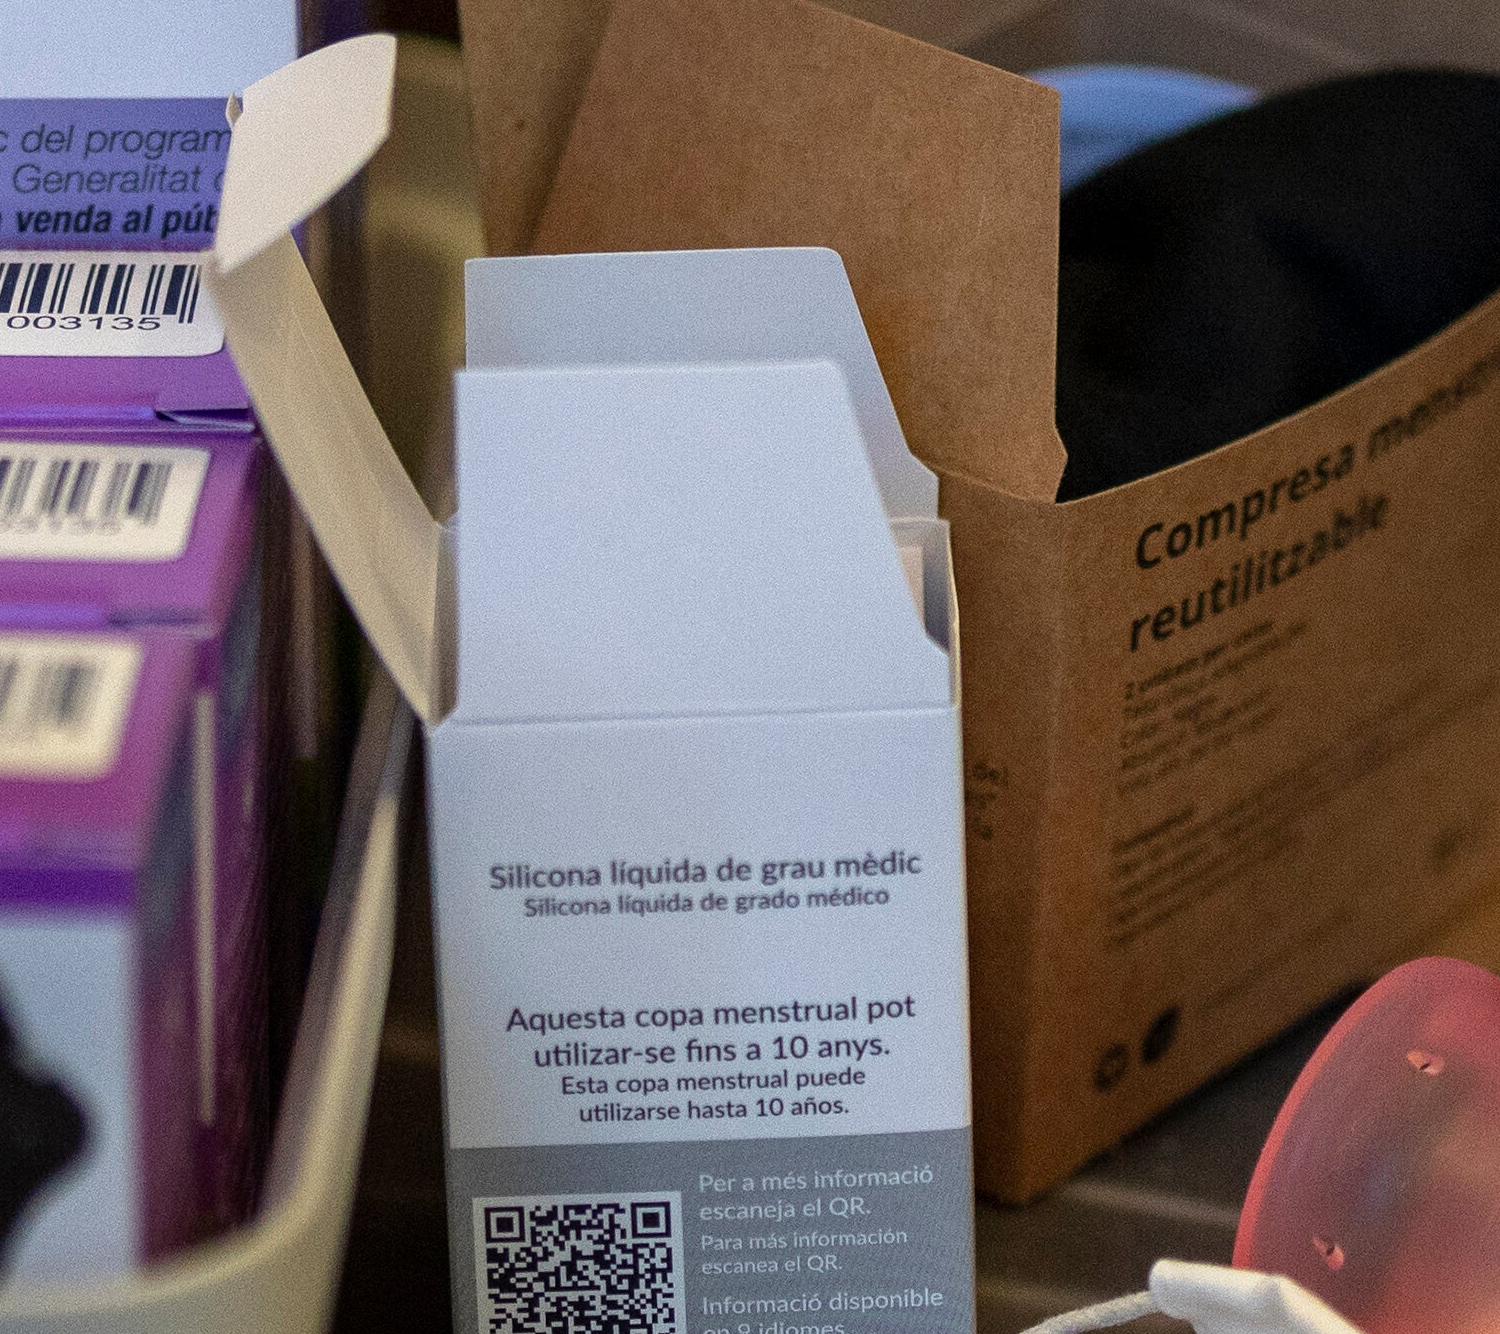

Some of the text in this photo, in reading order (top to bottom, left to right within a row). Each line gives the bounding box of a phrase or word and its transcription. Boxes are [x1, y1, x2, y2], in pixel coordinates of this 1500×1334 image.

[20, 124, 75, 155] del
[83, 129, 233, 165] program
[12, 164, 201, 195] Generalitat
[14, 205, 112, 236] venda
[122, 206, 154, 235] al
[6, 314, 162, 331] 003135
[1134, 442, 1357, 571] Compresa
[1128, 489, 1392, 653] reutilitzable
[490, 864, 601, 890] Silicona
[610, 859, 707, 890] líquida
[717, 858, 752, 881] de
[761, 858, 824, 885] grau
[524, 887, 890, 918] Silicona líquida de grado médico
[506, 995, 916, 1037] Aquesta copa menstrual pot
[534, 1035, 891, 1069] utilizar-se fins a 10 anys.
[561, 1068, 866, 1097] Esta copa menstrual puede
[578, 1097, 850, 1124] utilizarse hasta 10 años.
[700, 1165, 934, 1193] Per a més informació
[700, 1197, 871, 1223] escaneja el QR.
[700, 1228, 908, 1251] Para más información
[701, 1254, 843, 1276] escanea el QR.
[703, 1288, 944, 1316] Informació disponible
